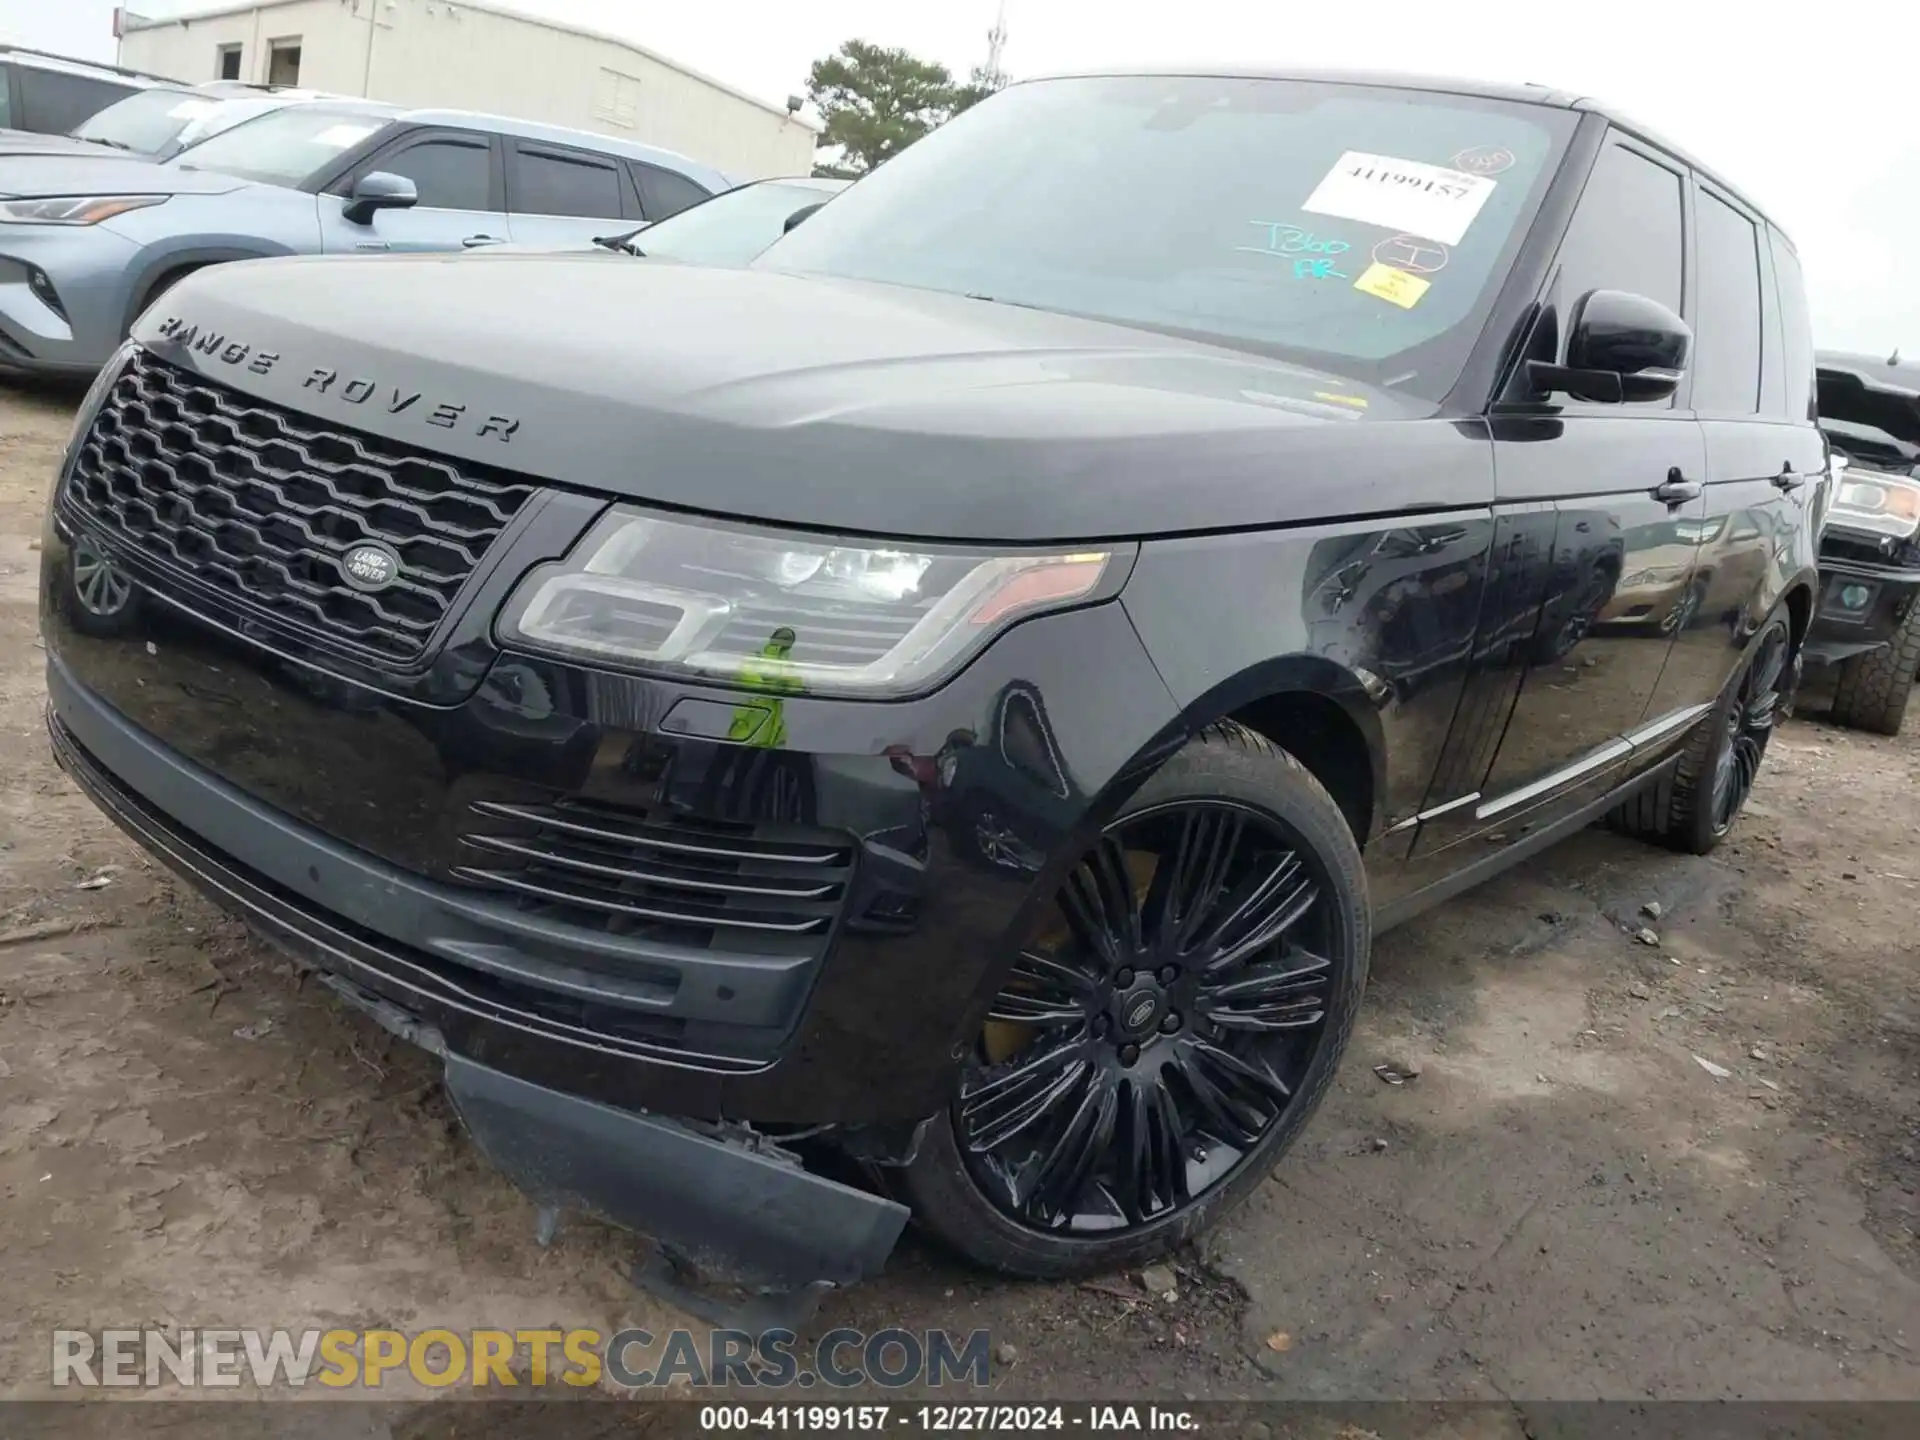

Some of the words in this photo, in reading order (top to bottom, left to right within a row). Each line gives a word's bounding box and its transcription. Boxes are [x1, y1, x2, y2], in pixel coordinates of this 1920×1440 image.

[1348, 166, 1470, 200] 41199157
[158, 317, 280, 375] RANGE
[302, 366, 520, 443] ROVER
[351, 562, 387, 582] ROVER
[354, 550, 384, 568] LAND
